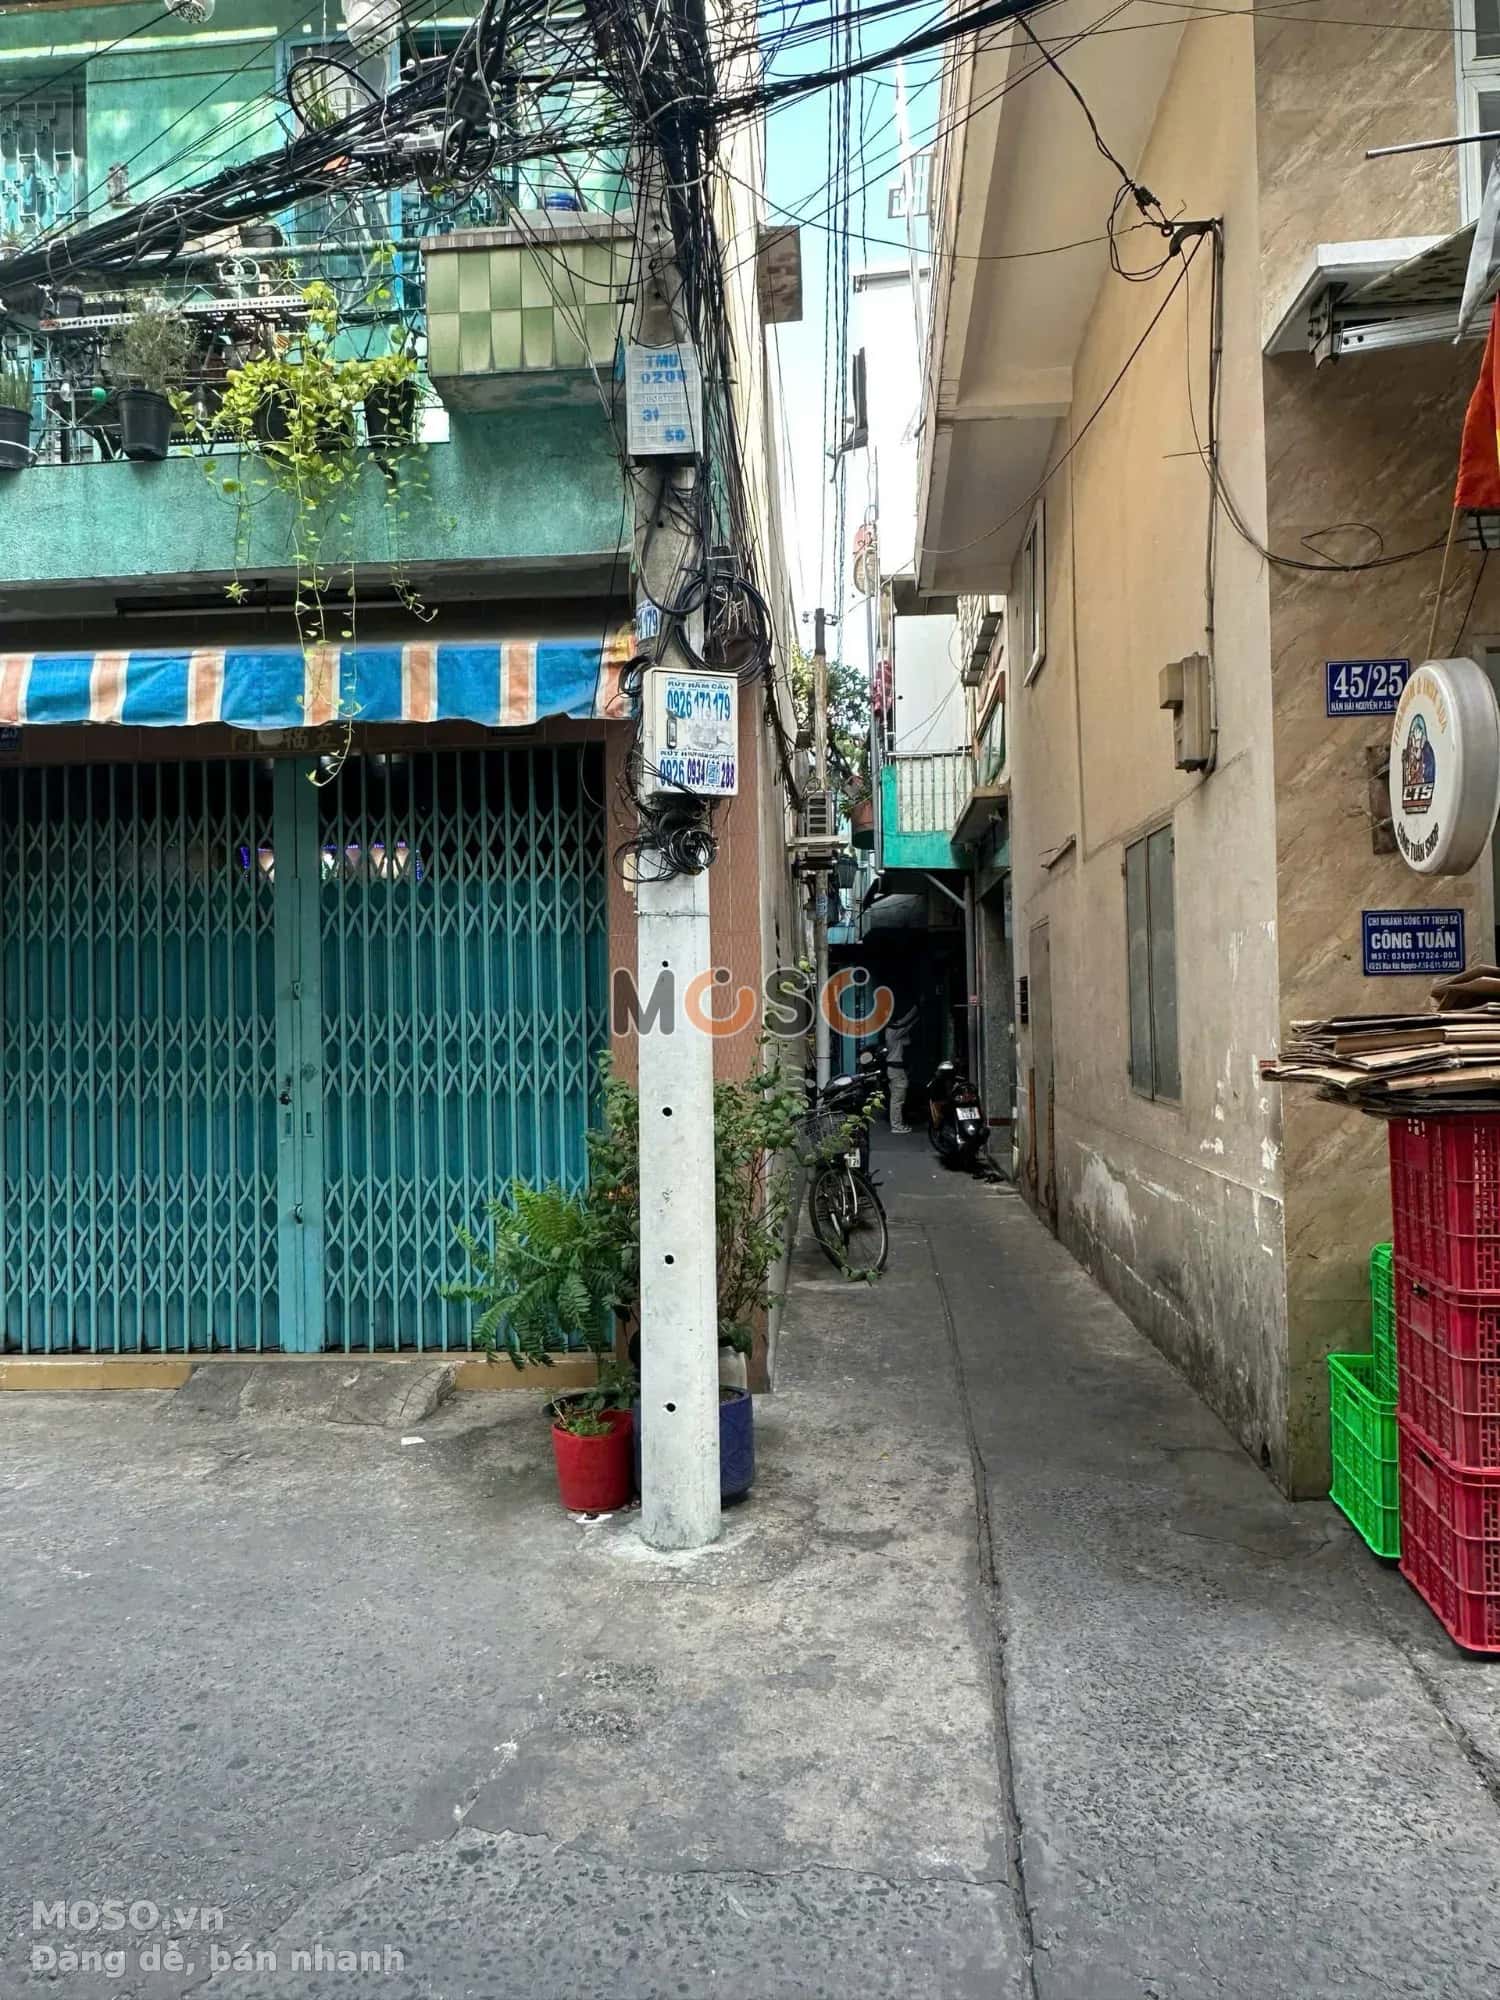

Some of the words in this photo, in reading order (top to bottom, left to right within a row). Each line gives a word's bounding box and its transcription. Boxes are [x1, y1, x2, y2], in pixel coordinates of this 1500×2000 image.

[1334, 664, 1403, 698] 45/25
[667, 690, 692, 719] 0926
[713, 691, 730, 720] 179
[1403, 783, 1433, 801] CTS
[1425, 822, 1439, 858] SHOP
[1371, 929, 1412, 949] CÔNG
[1416, 925, 1456, 949] TUẤN
[1371, 952, 1389, 960] MST:
